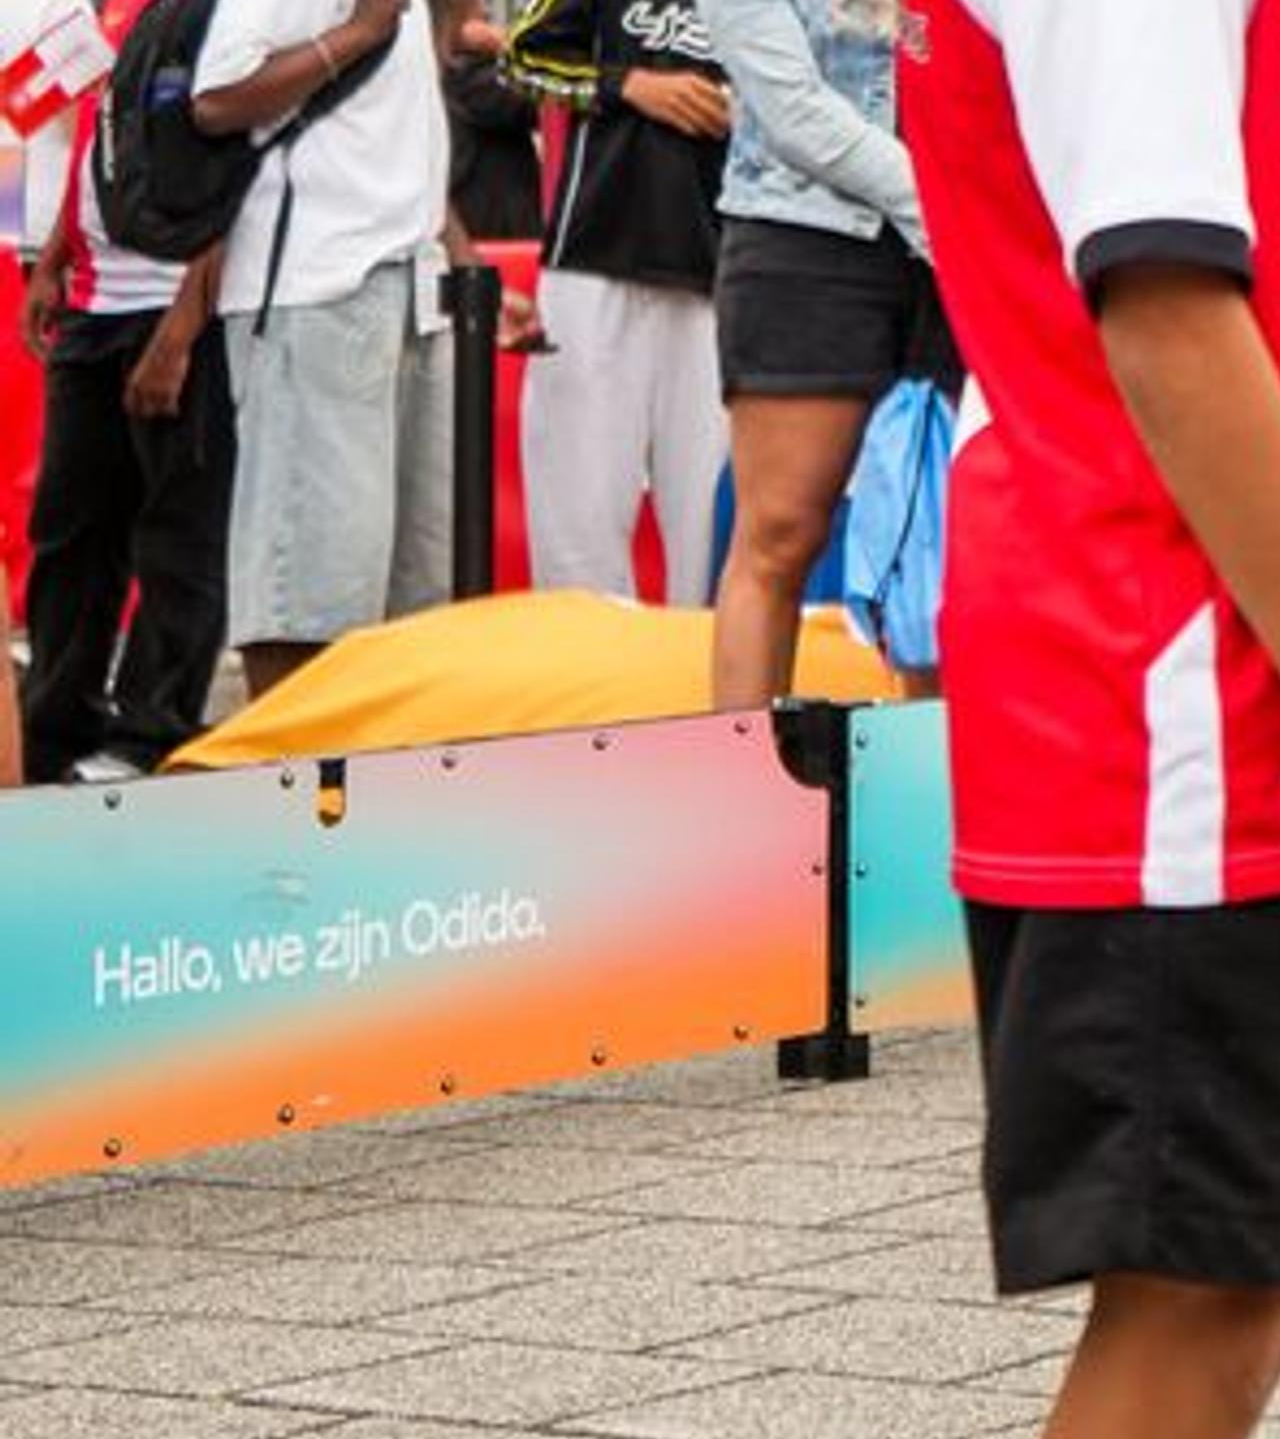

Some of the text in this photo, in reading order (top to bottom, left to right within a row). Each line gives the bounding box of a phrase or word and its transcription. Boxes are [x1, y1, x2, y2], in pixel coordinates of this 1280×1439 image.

[94, 887, 547, 1007] Hallo, we zijn Odido.
